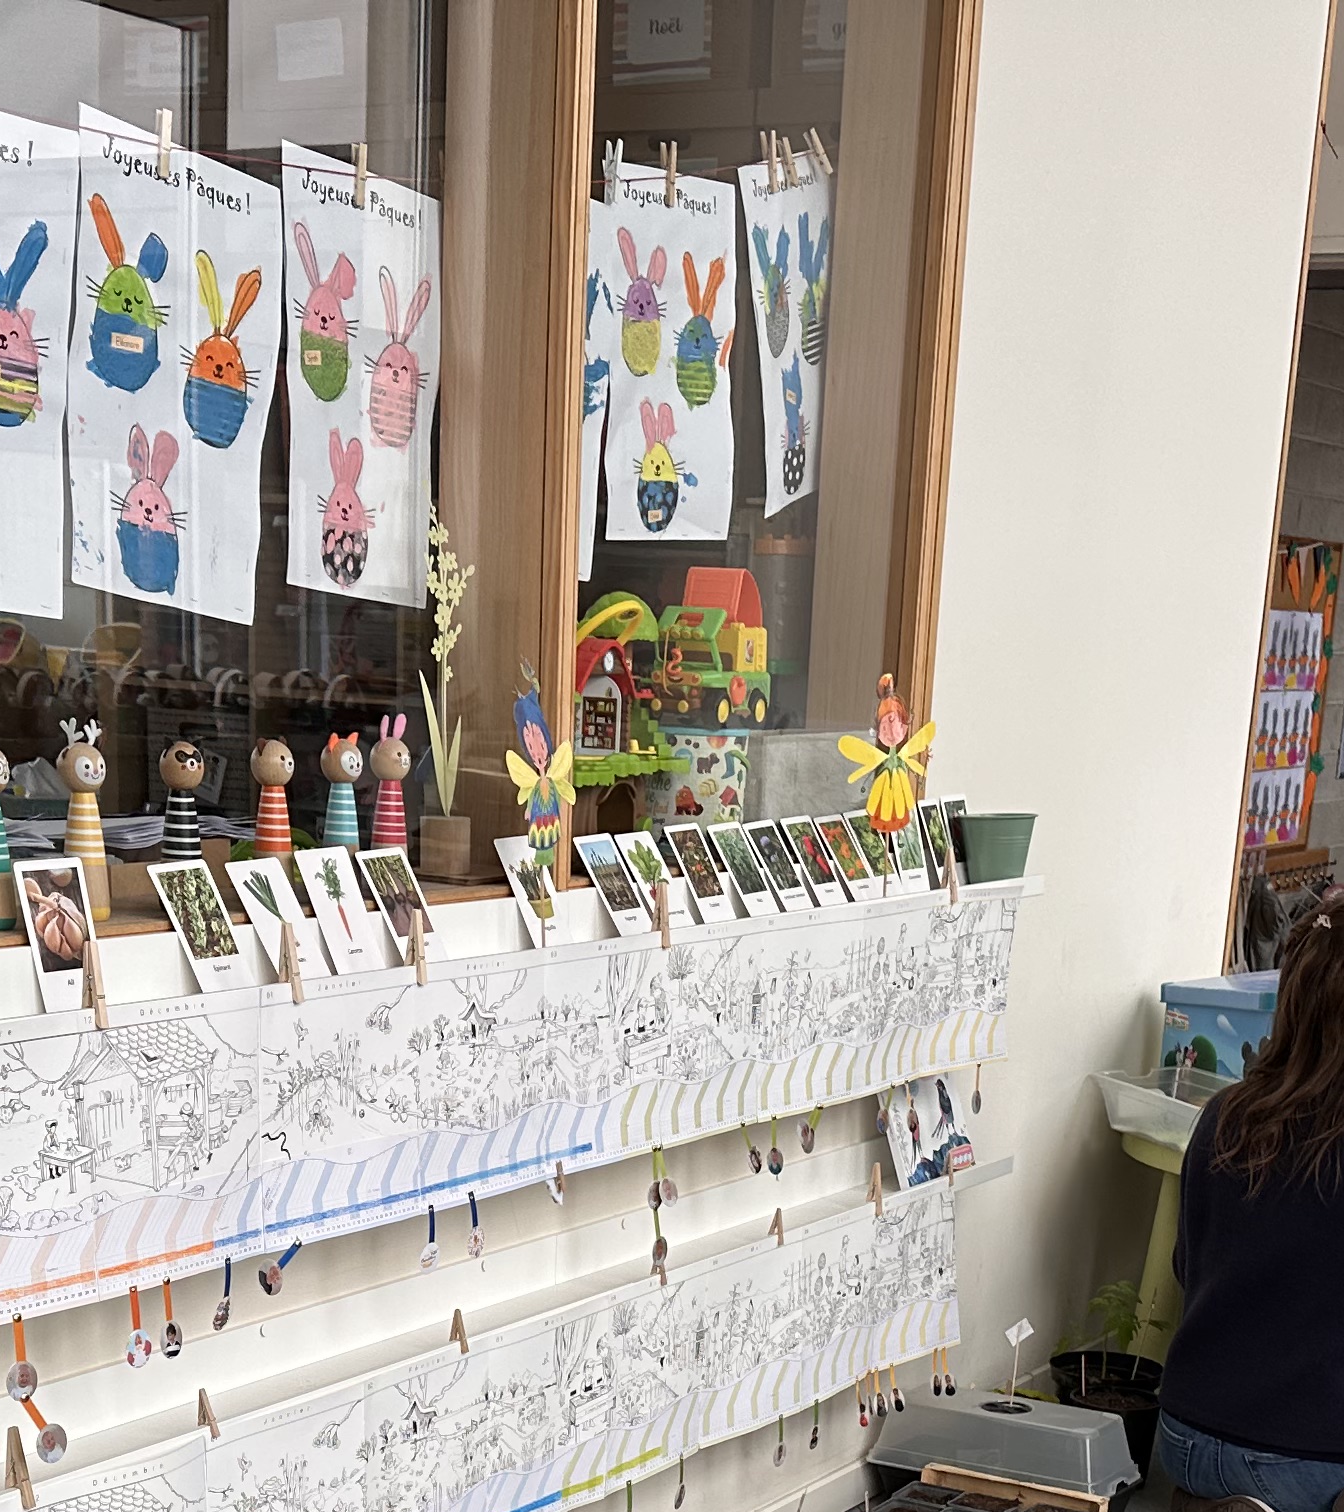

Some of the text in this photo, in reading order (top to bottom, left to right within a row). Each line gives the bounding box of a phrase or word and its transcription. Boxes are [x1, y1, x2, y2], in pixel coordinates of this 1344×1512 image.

[186, 167, 242, 210] Pâques
[675, 188, 711, 217] Pâques
[370, 190, 414, 228] Pâques
[83, 1015, 93, 1025] 12
